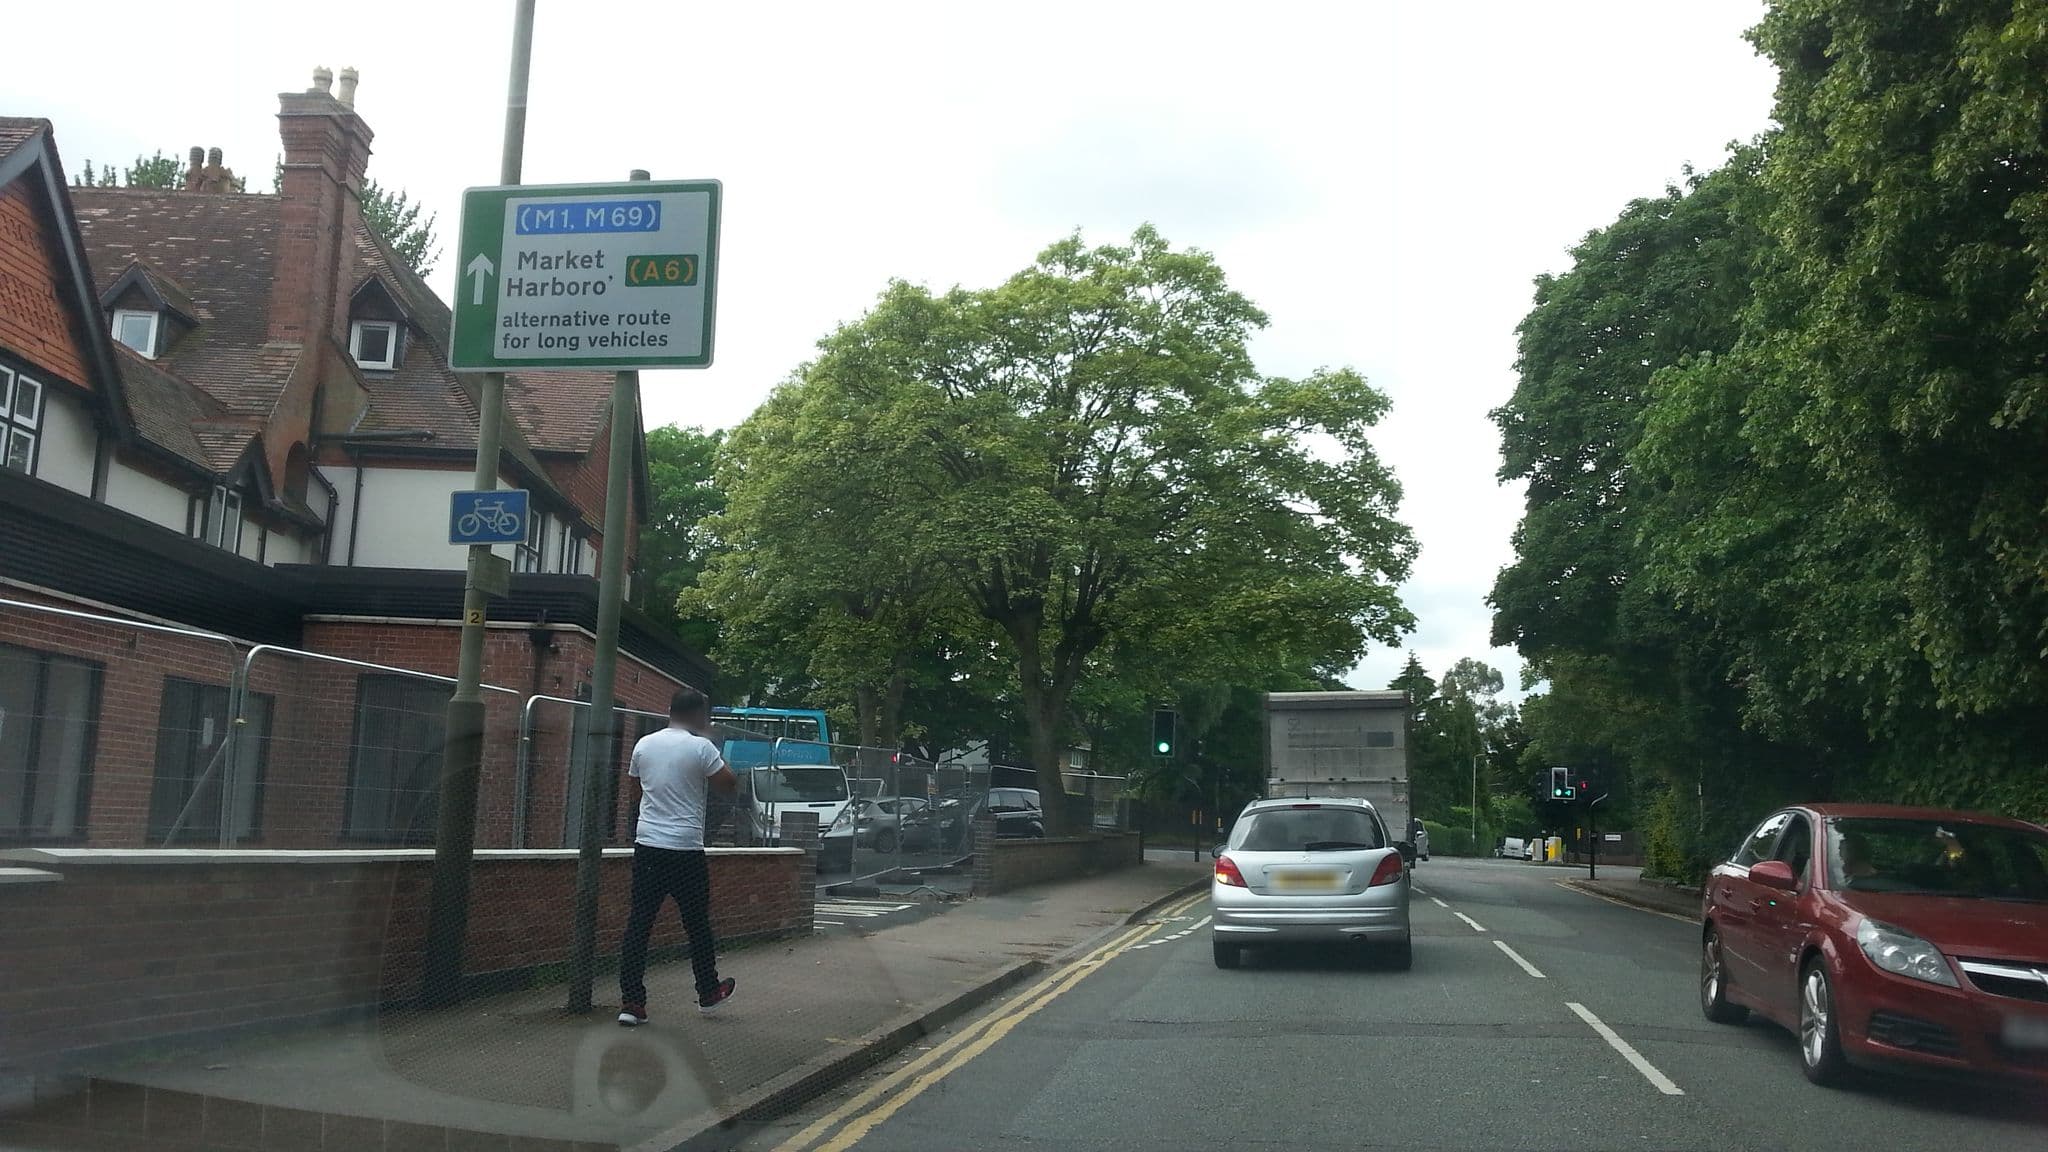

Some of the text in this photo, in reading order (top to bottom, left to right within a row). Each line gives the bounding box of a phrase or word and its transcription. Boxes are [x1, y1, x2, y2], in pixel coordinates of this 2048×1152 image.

[520, 207, 575, 231] (M1,
[518, 249, 605, 271] Market
[629, 257, 695, 284] (A6)
[506, 274, 613, 297] Harboro'
[502, 309, 671, 328] alternative route
[502, 331, 668, 351] for long vehicles
[470, 611, 480, 624] 2
